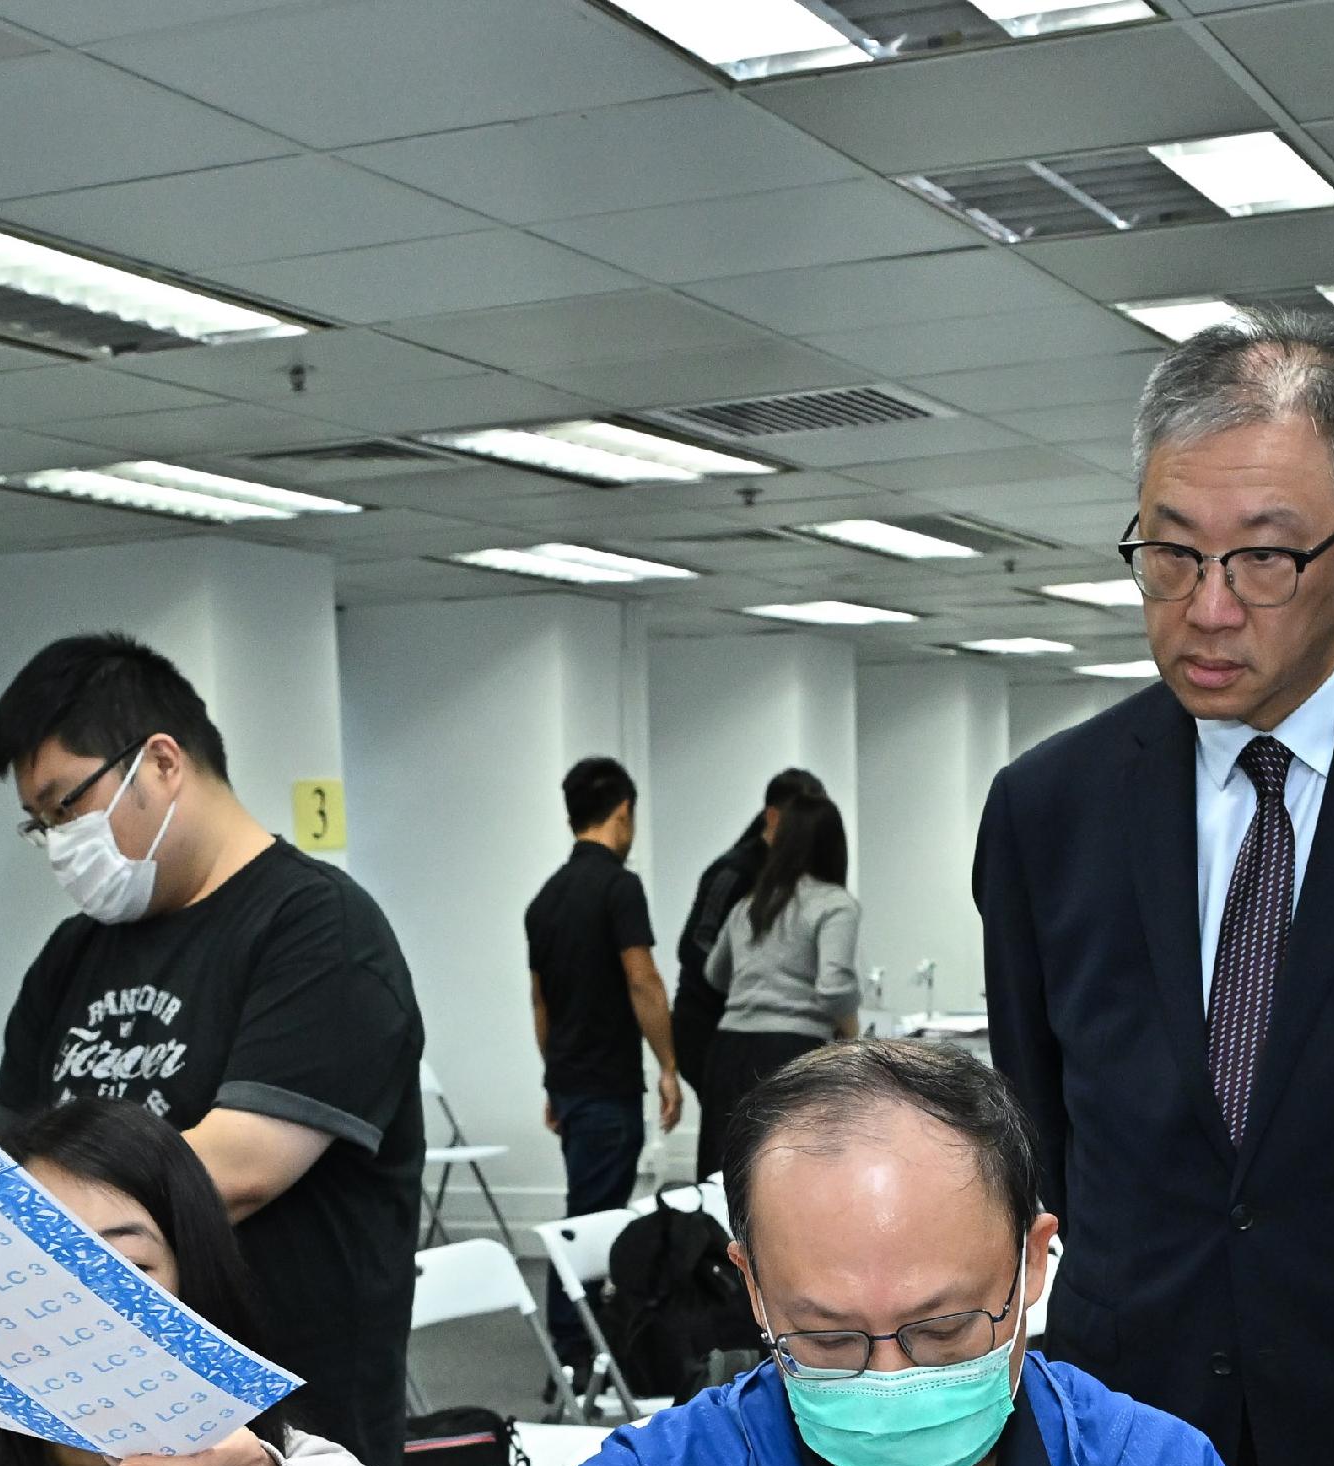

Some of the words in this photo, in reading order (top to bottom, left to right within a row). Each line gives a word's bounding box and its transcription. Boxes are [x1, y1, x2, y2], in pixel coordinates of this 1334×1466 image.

[312, 787, 328, 839] 3
[29, 1264, 47, 1276] 3
[26, 1300, 61, 1320] LC
[64, 1292, 81, 1304] 3
[59, 1328, 94, 1346] LC
[97, 1319, 114, 1332] 3
[34, 1344, 50, 1356] 3
[93, 1355, 126, 1372] LC
[130, 1345, 146, 1358] 3
[29, 1378, 64, 1396] LC
[66, 1371, 82, 1384] 3
[124, 1379, 158, 1398] LC
[162, 1371, 177, 1380] 3
[63, 1404, 96, 1420] LC
[98, 1397, 114, 1408] 3
[155, 1403, 188, 1421] LC
[191, 1392, 207, 1402] 3
[93, 1429, 127, 1444] LC
[130, 1422, 146, 1433] 3
